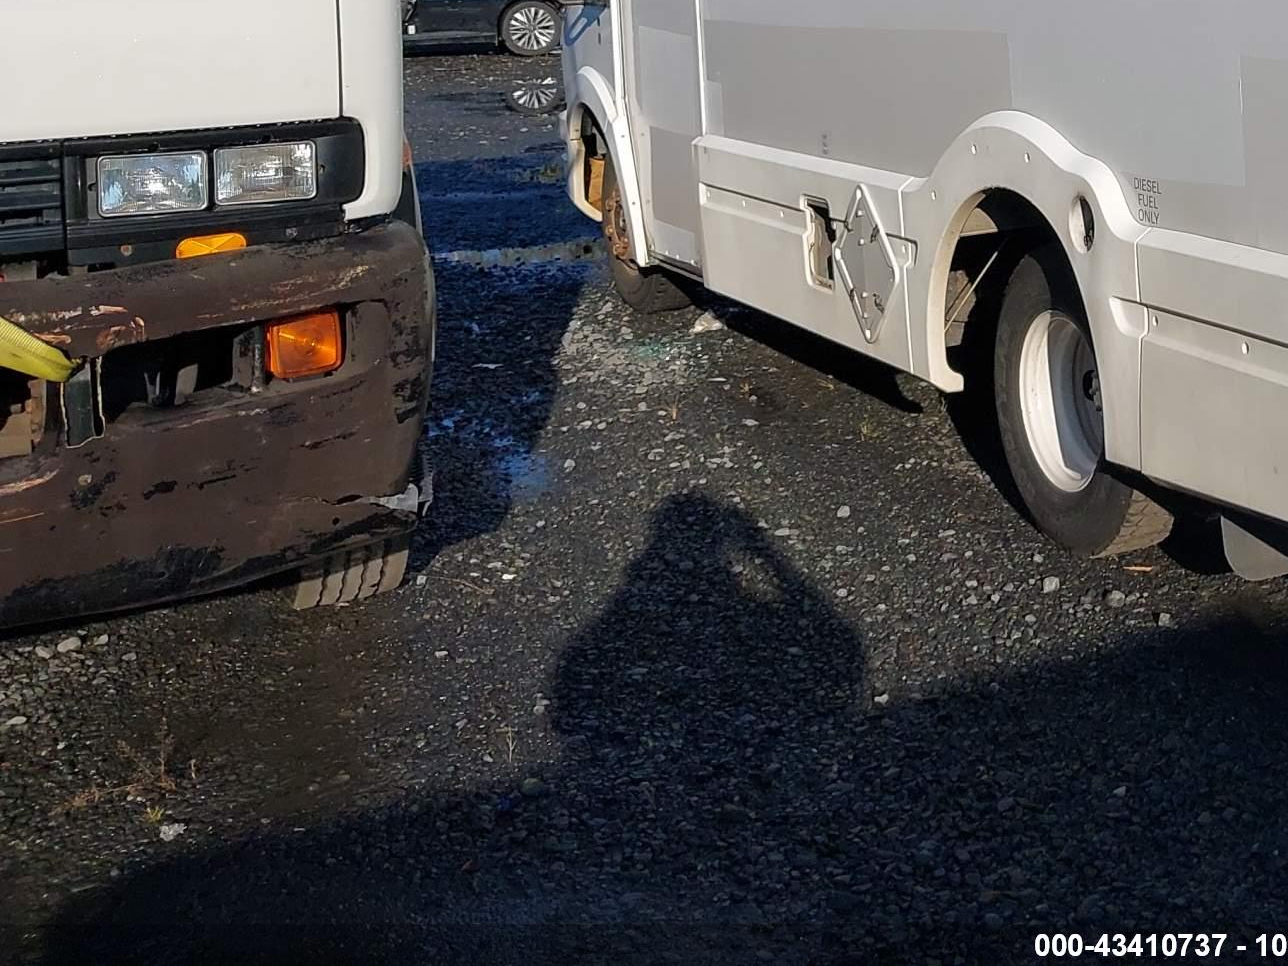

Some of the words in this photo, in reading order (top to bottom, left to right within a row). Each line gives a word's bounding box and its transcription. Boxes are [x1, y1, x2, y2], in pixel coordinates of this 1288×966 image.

[1133, 177, 1162, 195] DIESEL
[1138, 193, 1159, 210] FUEL
[1138, 208, 1160, 225] ONLY
